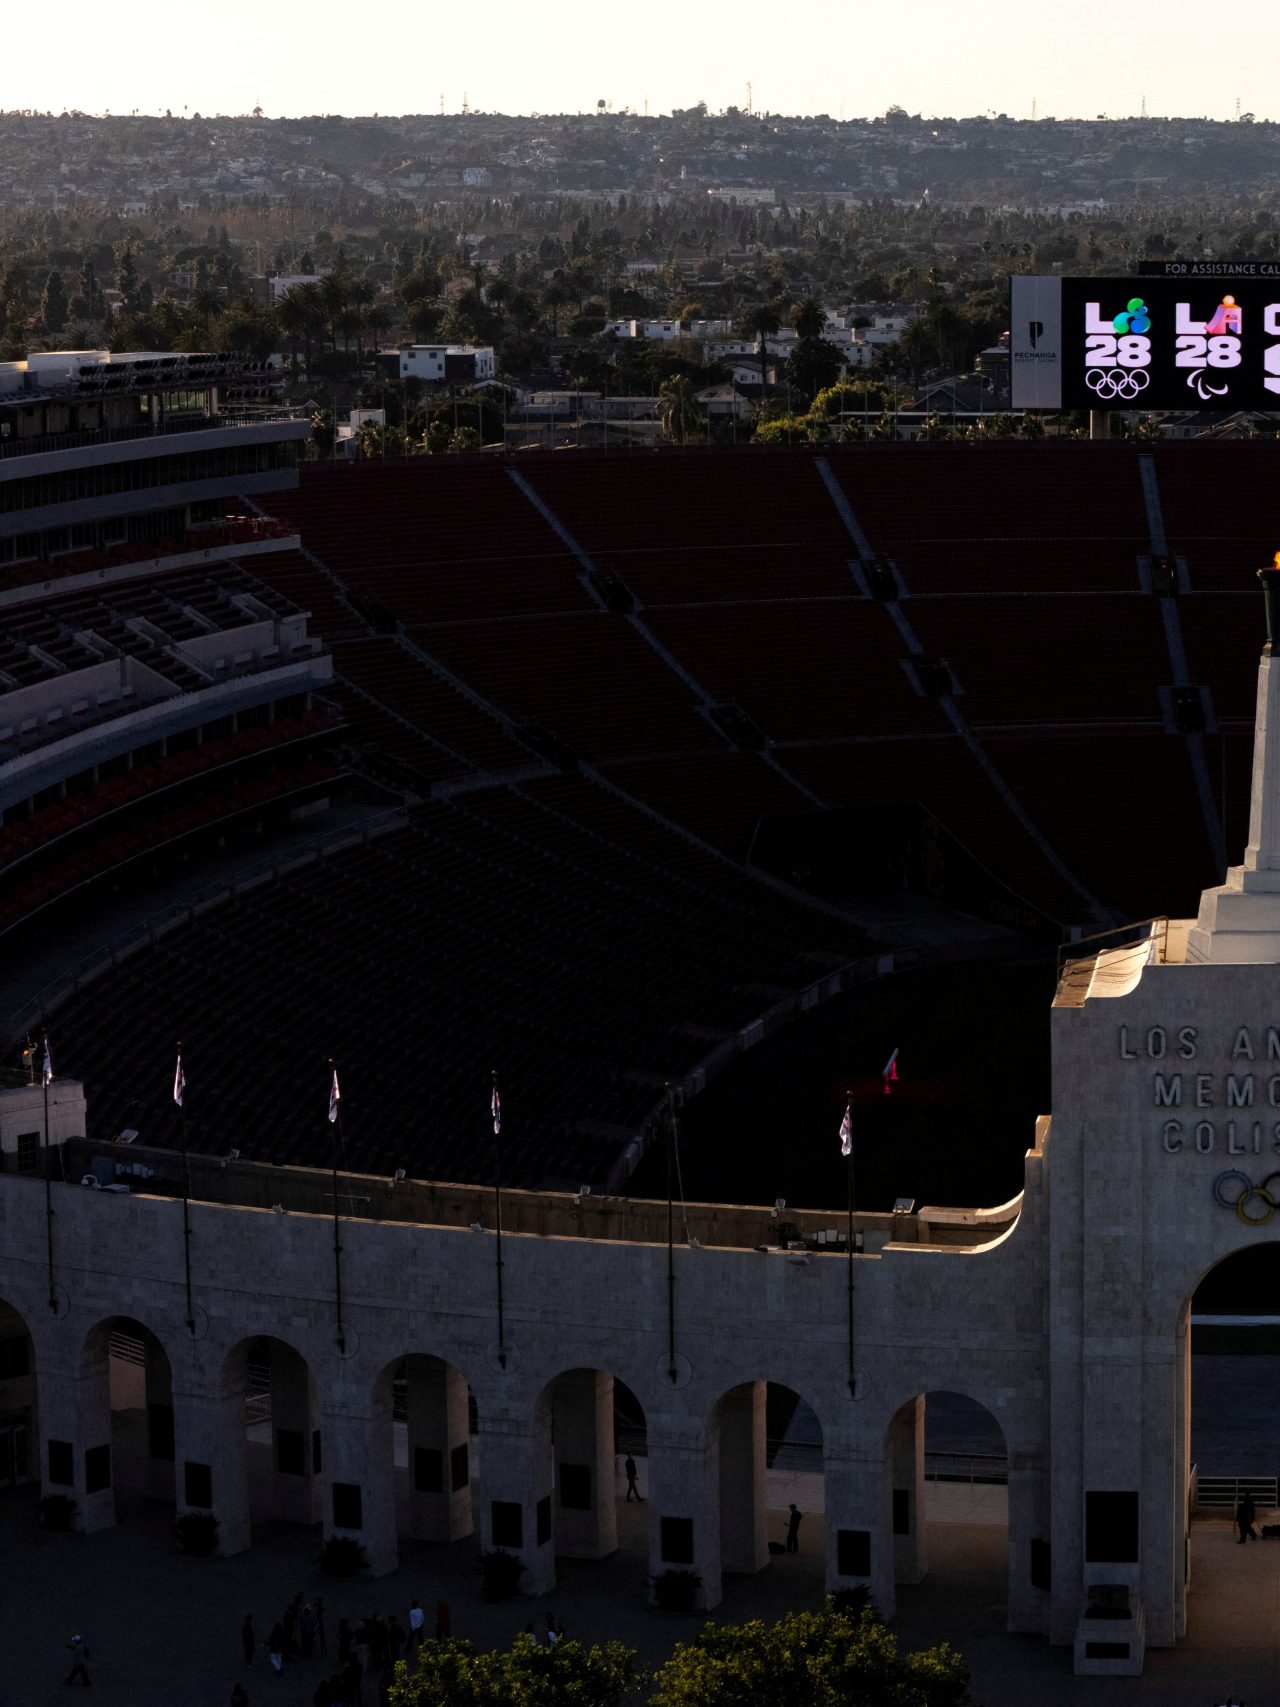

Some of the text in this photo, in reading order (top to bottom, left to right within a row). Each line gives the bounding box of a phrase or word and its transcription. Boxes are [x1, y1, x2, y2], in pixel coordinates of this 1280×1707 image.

[1165, 263, 1187, 274] FOR
[1191, 263, 1256, 275] ASSISTANCE
[1085, 335, 1152, 368] 28
[1175, 335, 1242, 369] 28
[1120, 1026, 1198, 1060] LOS
